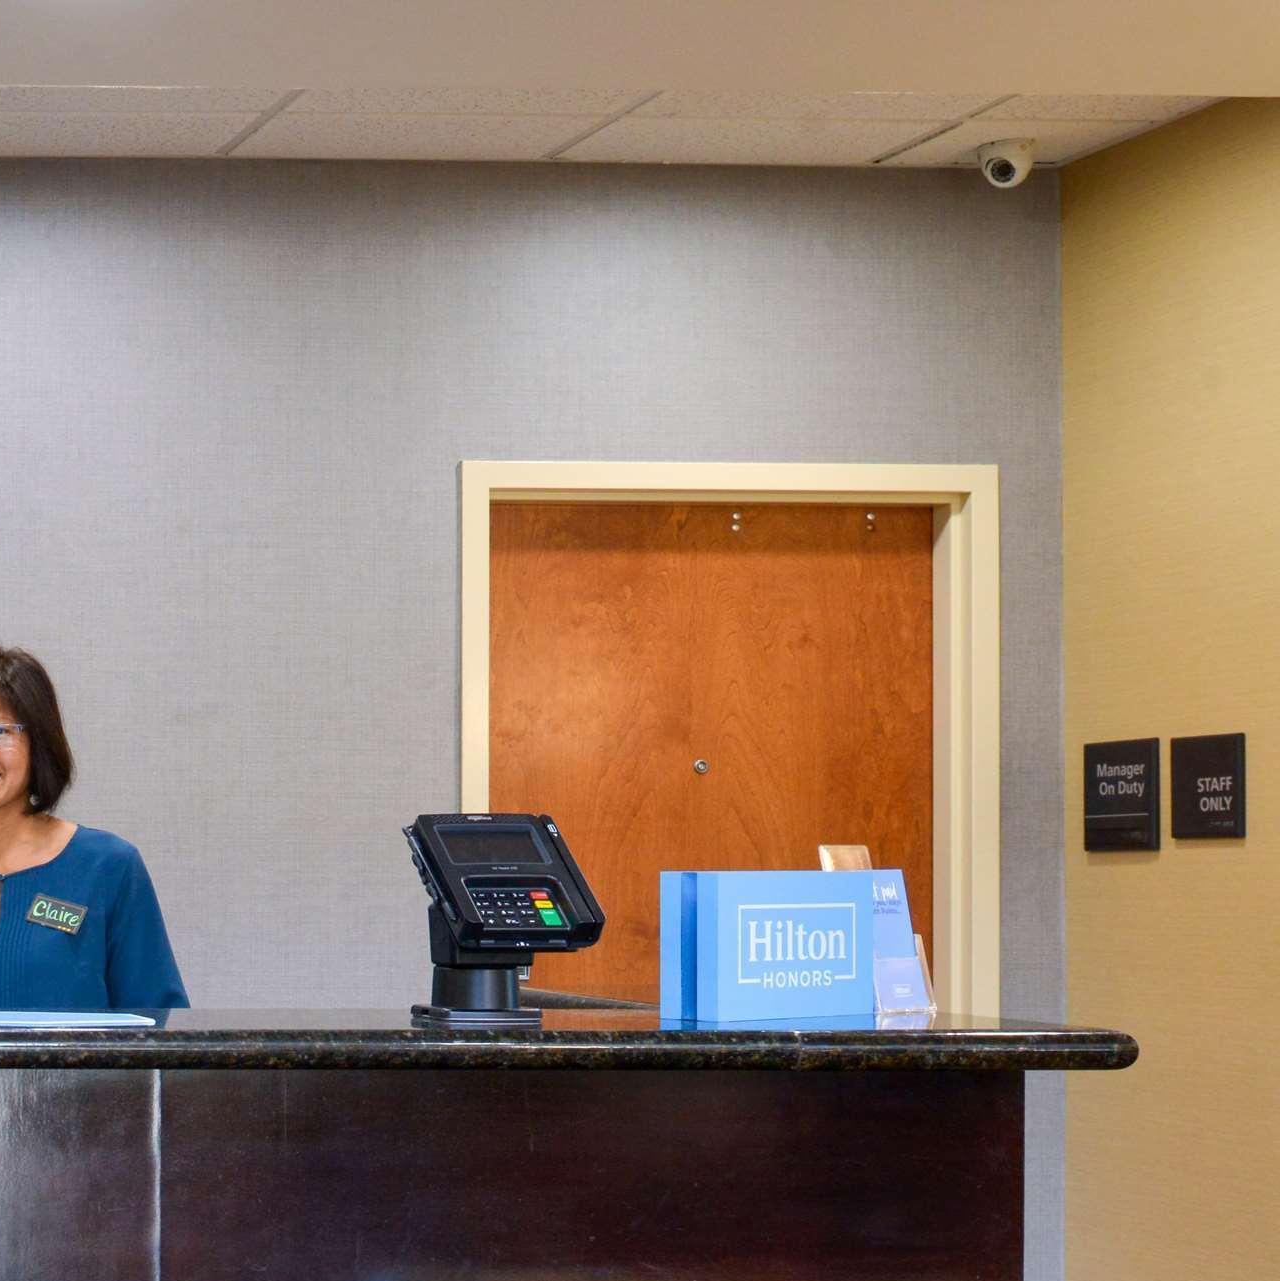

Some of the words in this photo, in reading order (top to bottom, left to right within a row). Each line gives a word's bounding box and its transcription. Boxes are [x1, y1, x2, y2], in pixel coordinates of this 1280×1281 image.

[1096, 763, 1145, 779] Manager
[1099, 782, 1115, 796] On
[1118, 780, 1145, 798] Duty
[1197, 776, 1233, 793] STAFF
[1199, 796, 1233, 812] ONLY
[32, 900, 81, 927] Claire
[747, 919, 847, 963] Hilton
[762, 969, 833, 989] HONORS
